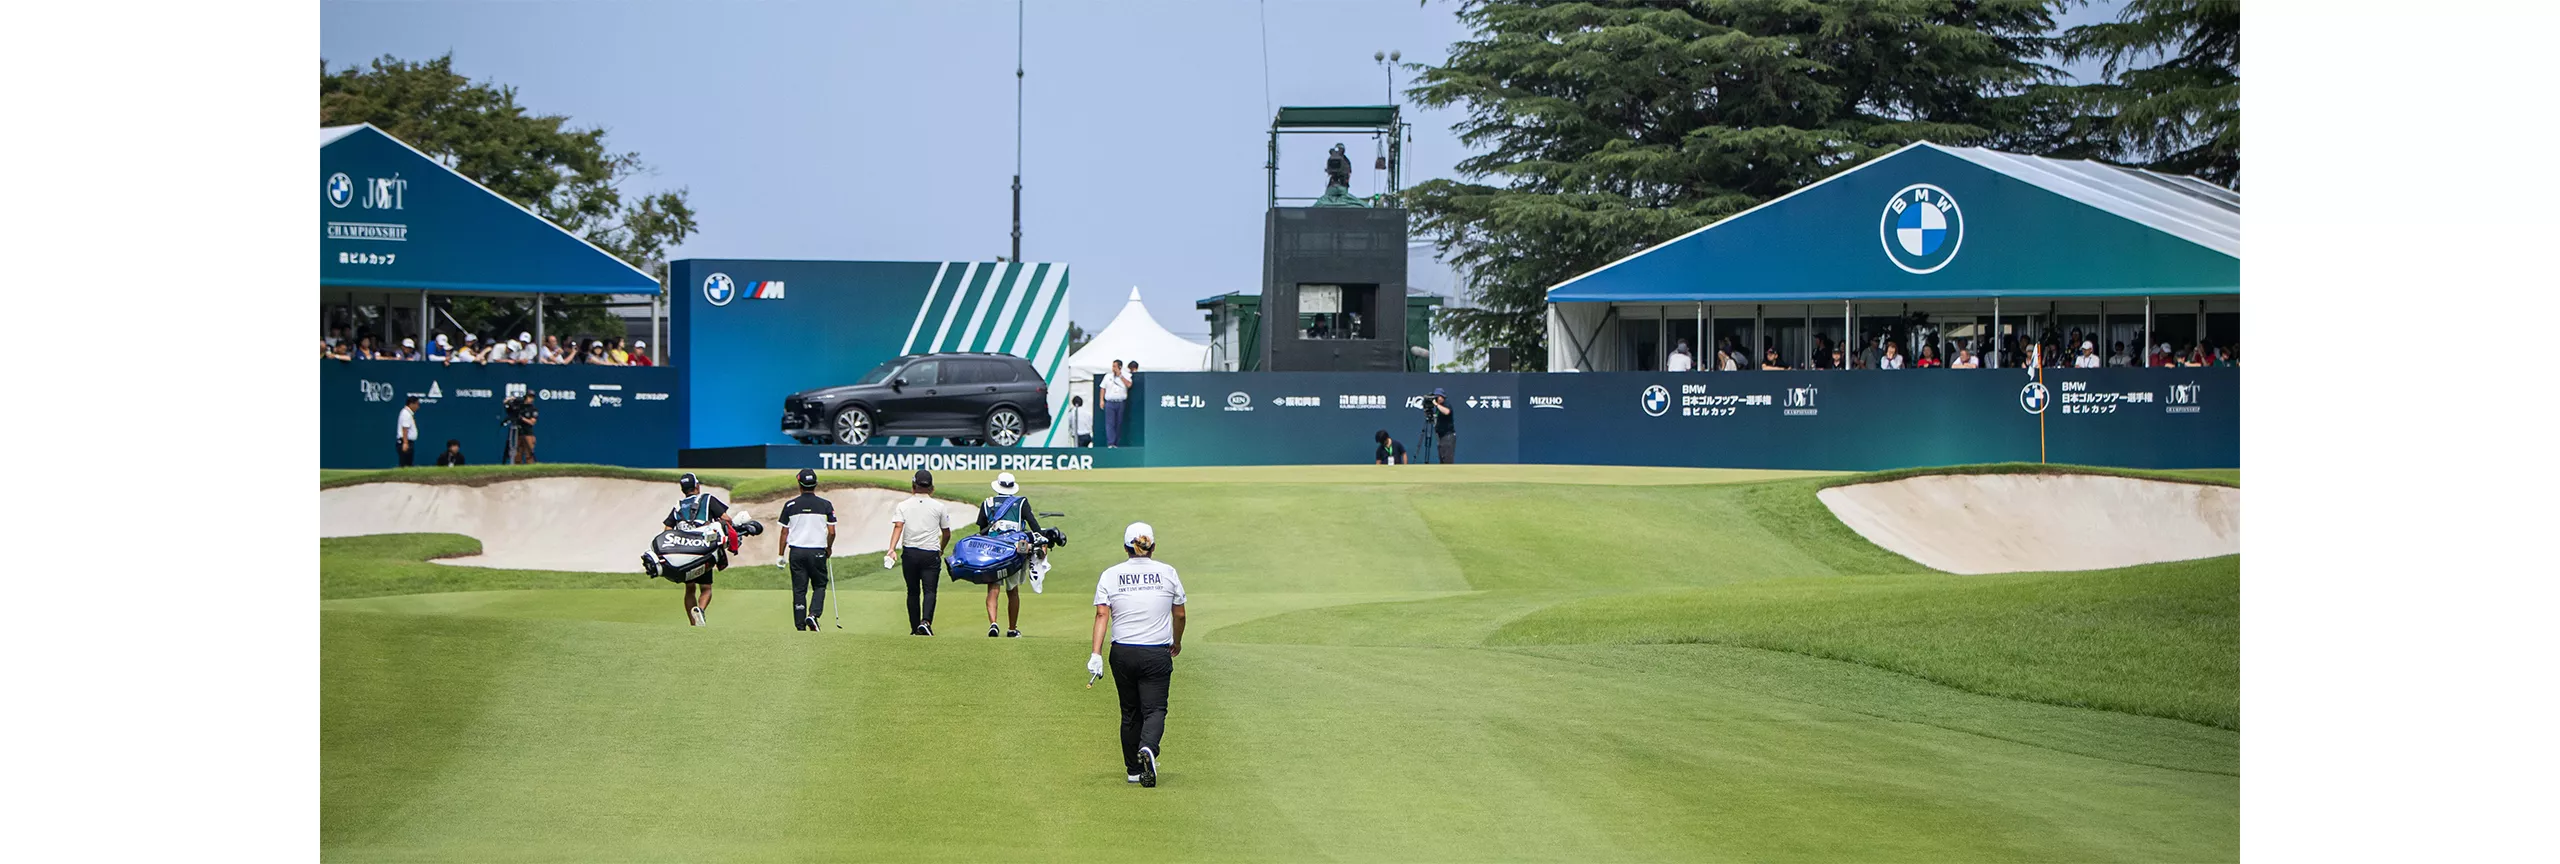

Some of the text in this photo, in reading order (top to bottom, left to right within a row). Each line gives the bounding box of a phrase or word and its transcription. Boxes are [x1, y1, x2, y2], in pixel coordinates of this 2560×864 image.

[1892, 189, 1953, 215] BMW
[327, 225, 408, 239] CHAMPIONSHIP
[1682, 384, 1707, 394] BMW
[2061, 382, 2087, 391] BMW
[1161, 395, 1206, 408] 森ビル
[1530, 397, 1563, 405] MIZUHO
[1682, 395, 1771, 406] 日本ゴルフツアー選手権
[2061, 393, 2153, 403] 日本ゴルフツアー選手権
[819, 453, 1094, 471] THE CHAMPIONSHIP PRIZE CAR
[662, 533, 711, 548] SRIXON
[1119, 573, 1161, 585] NEW ERA
